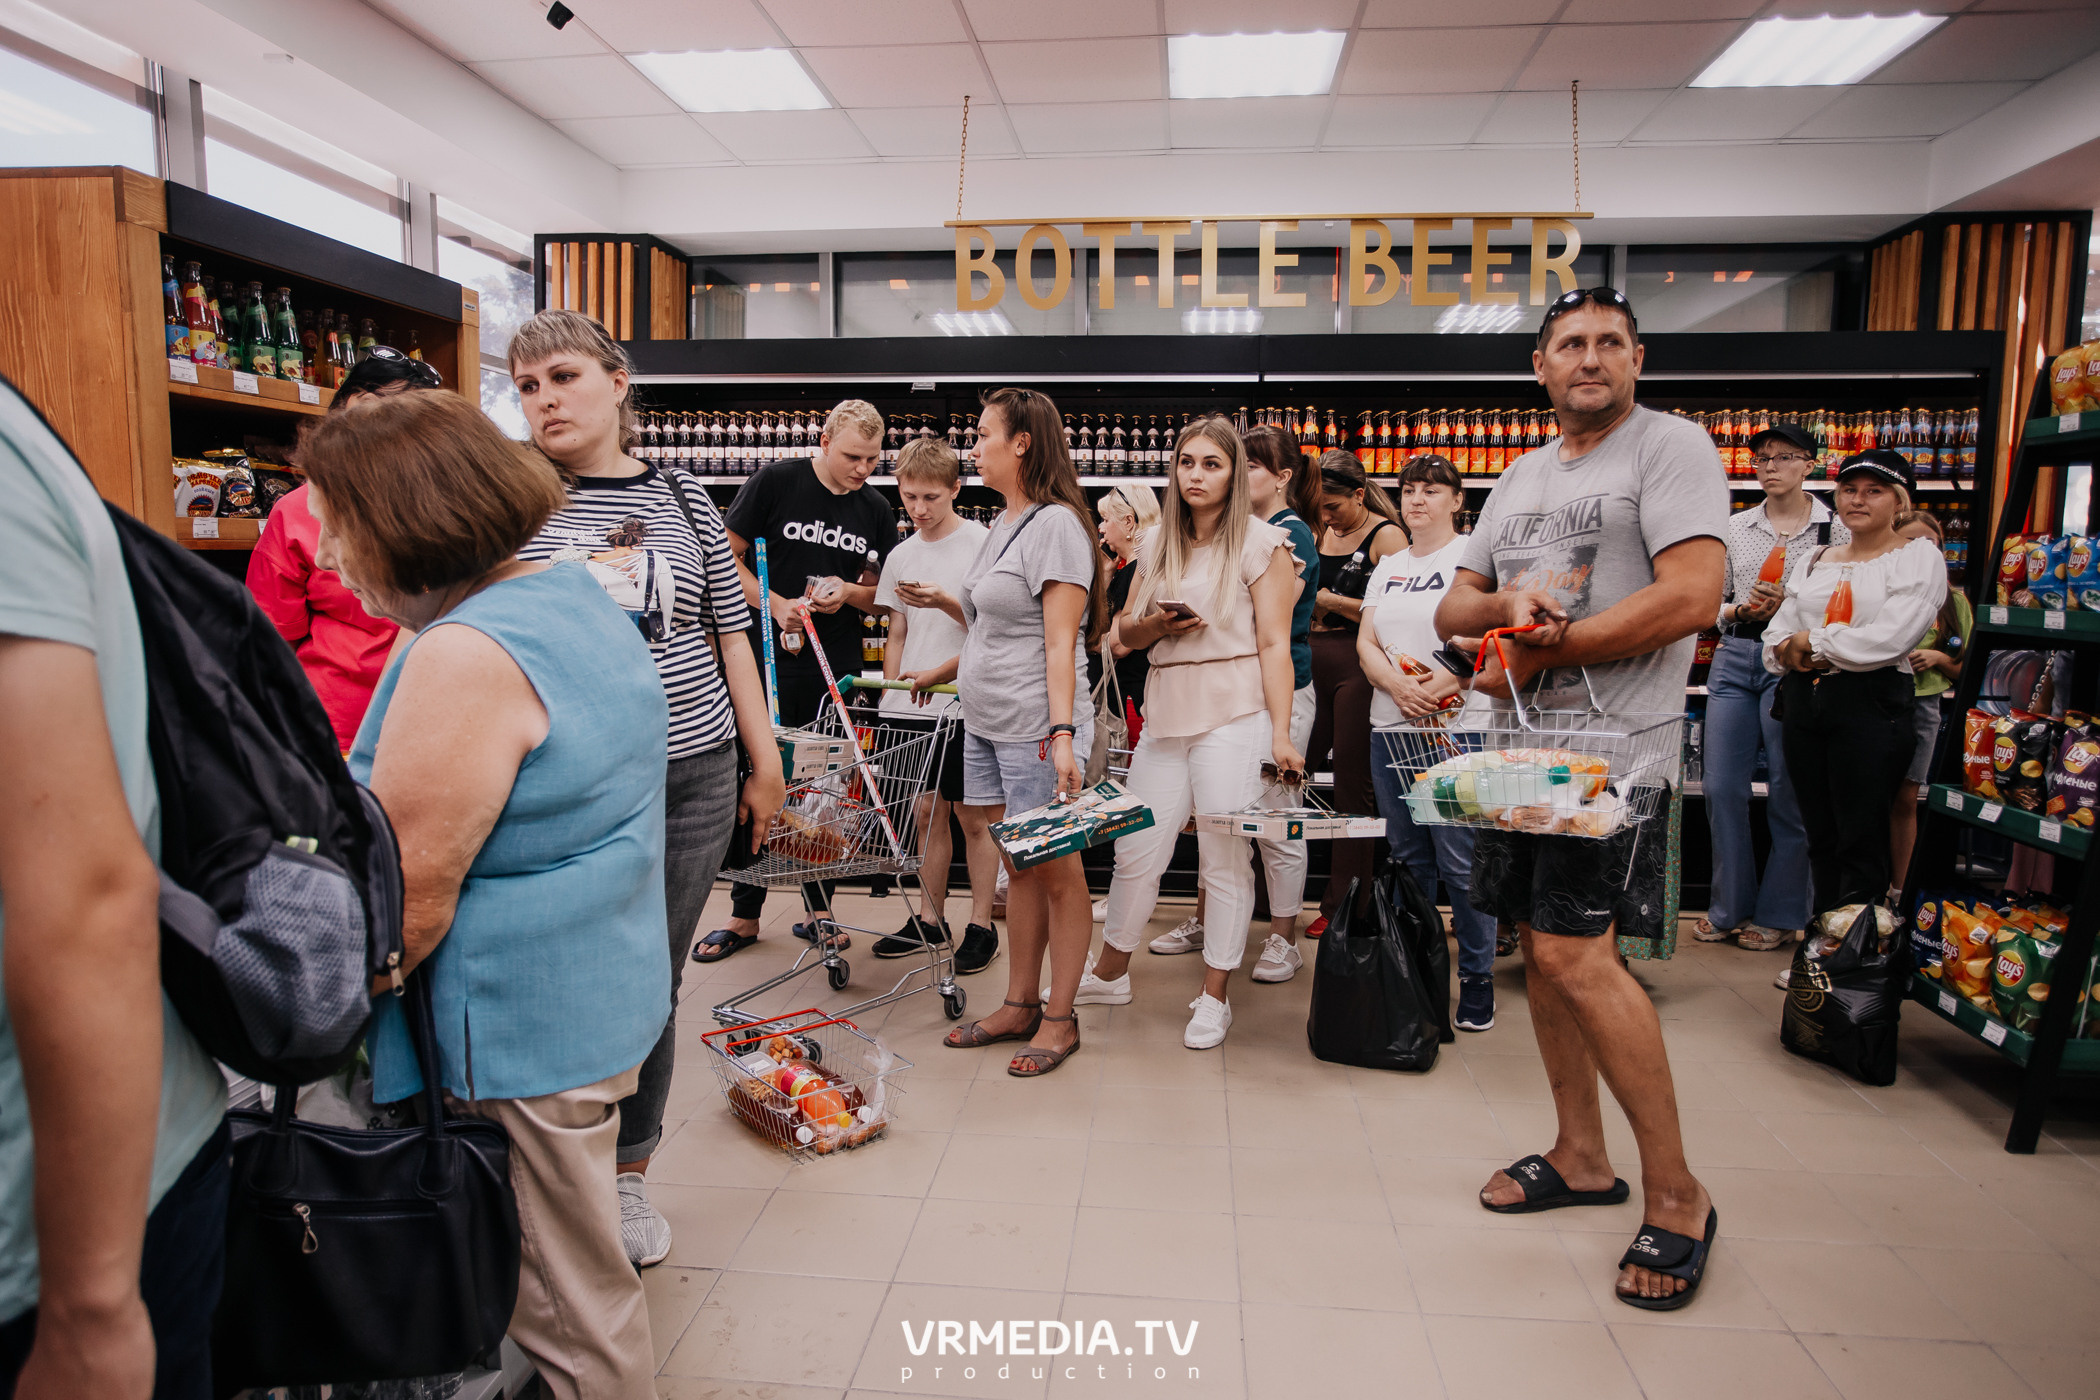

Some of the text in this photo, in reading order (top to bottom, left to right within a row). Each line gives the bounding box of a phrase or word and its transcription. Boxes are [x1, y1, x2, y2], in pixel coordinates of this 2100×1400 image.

[955, 218, 1582, 312] BOTTLE BEER
[1492, 498, 1603, 550] CALIFORNIA
[783, 520, 867, 554] adidas
[1551, 536, 1585, 551] SUNSET
[1385, 571, 1444, 594] FILA
[1994, 744, 2014, 764] Lay's
[1918, 907, 1935, 925] Lay's
[1996, 955, 2023, 979] Lay's
